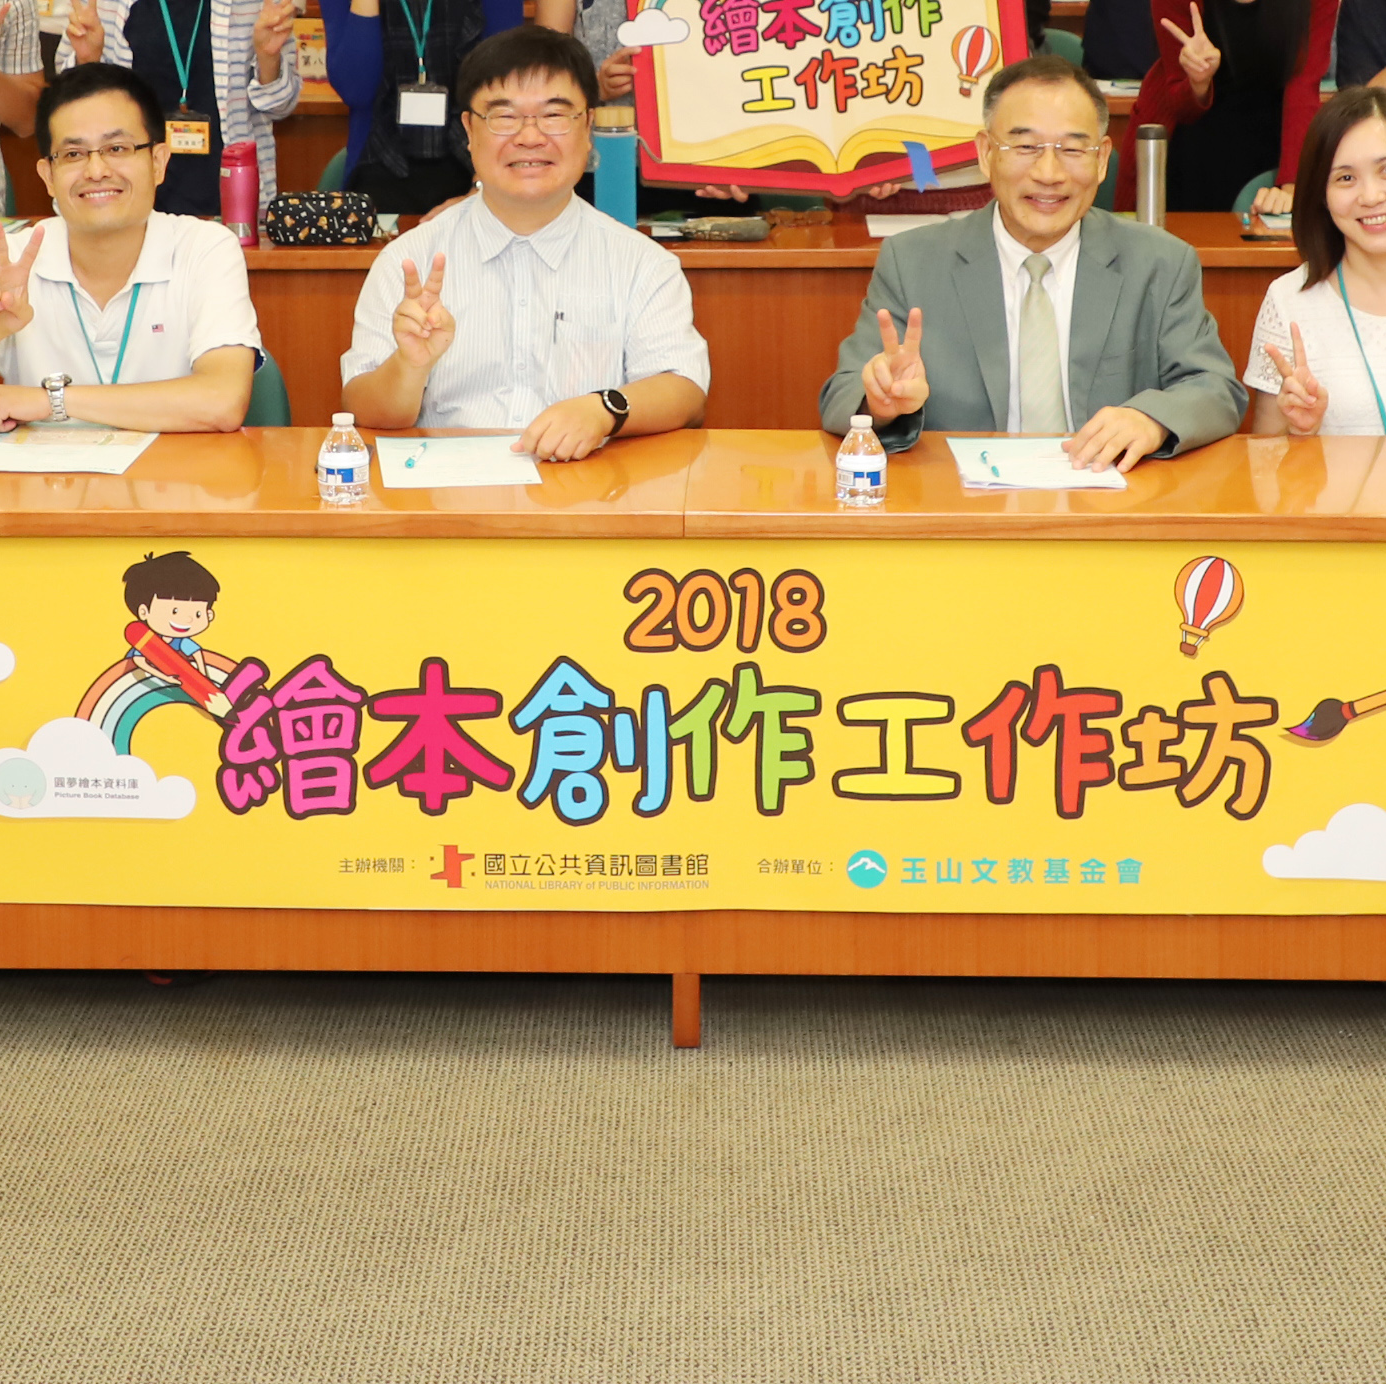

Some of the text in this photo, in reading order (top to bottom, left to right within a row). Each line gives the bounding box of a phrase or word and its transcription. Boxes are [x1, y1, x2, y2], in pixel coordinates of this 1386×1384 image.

[741, 45, 923, 114] 工作坊
[624, 568, 827, 653] 2018
[216, 653, 1279, 826] 繪本創作工作坊
[54, 777, 139, 789] 圓夢繪本資料庫
[484, 853, 709, 876] 國立公共資訊圖書館
[900, 857, 1144, 884] 玉山文教基金會
[485, 880, 709, 891] NATIONAL LIBRARY of PUBLIC INFORMATION
